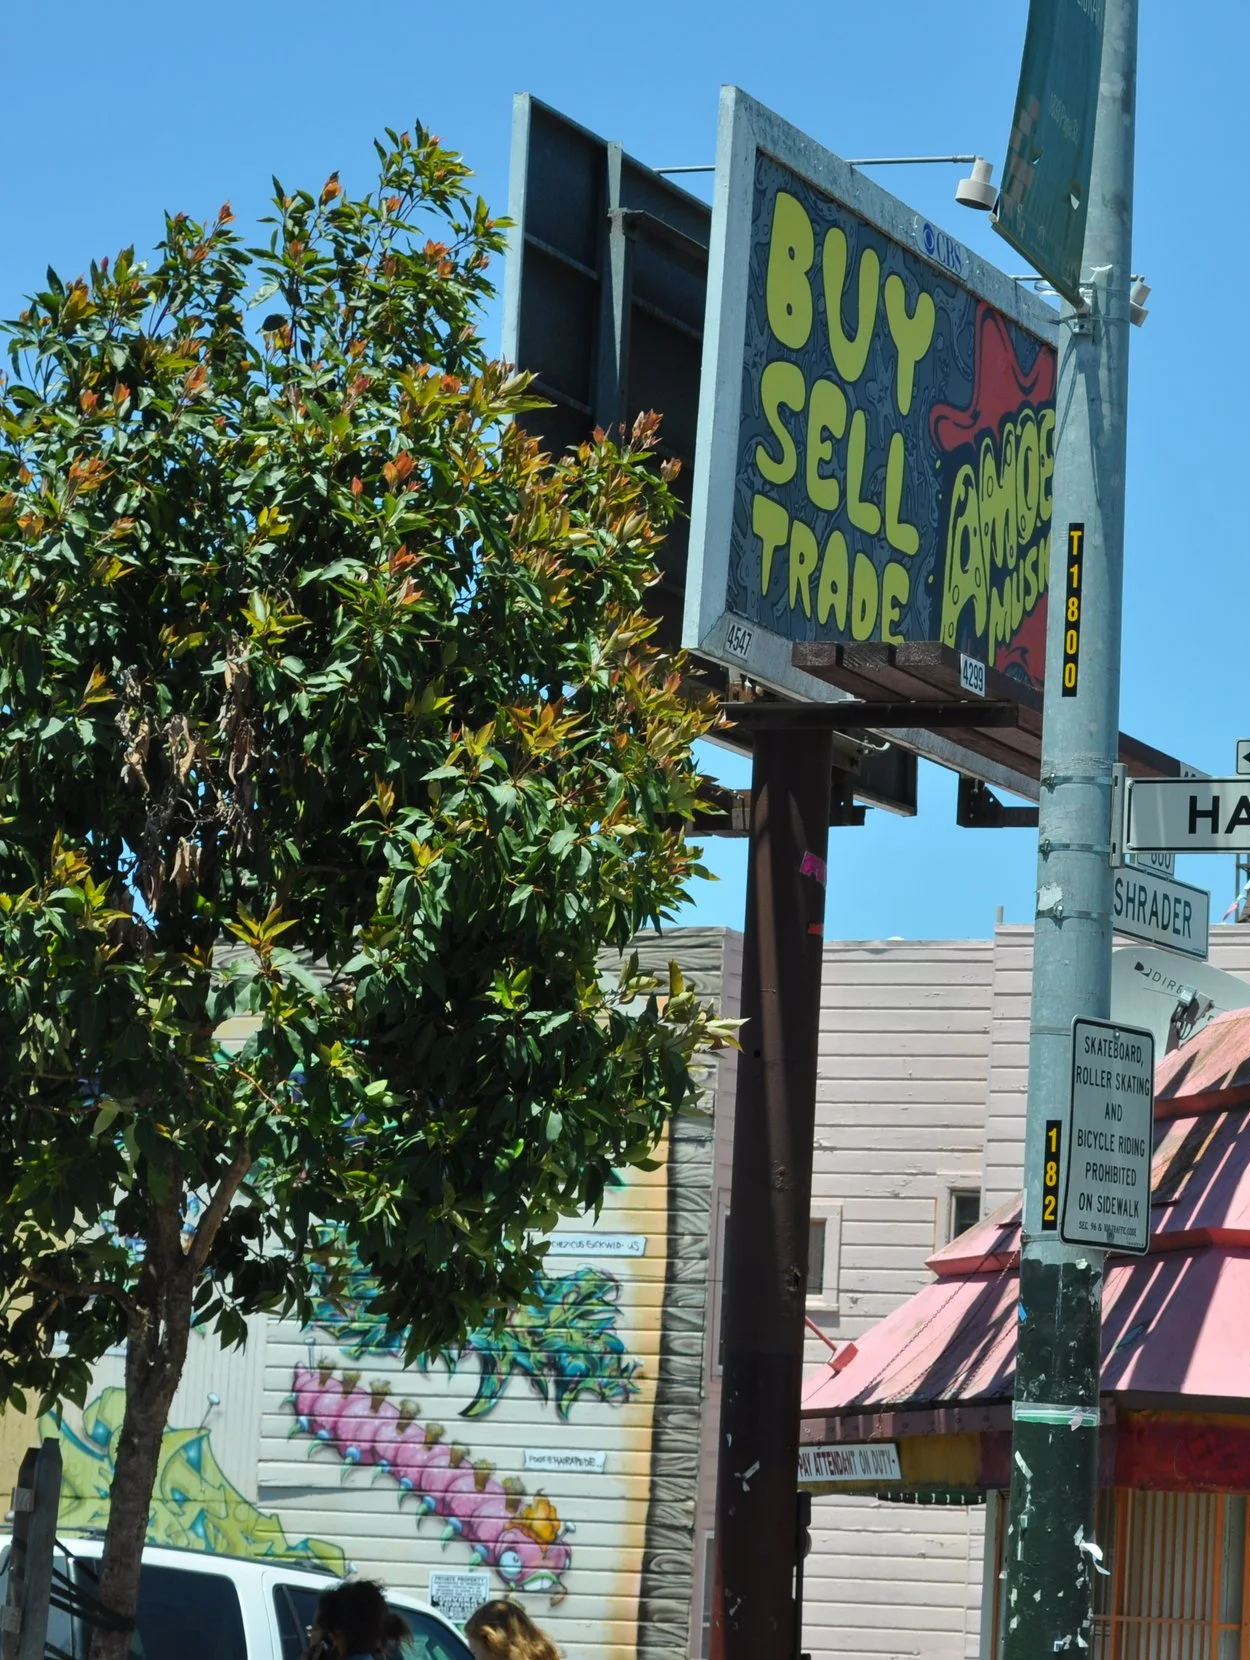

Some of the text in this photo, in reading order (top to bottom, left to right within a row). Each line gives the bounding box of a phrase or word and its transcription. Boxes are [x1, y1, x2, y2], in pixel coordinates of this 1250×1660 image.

[937, 232, 961, 274] CBS
[766, 191, 936, 416] BUY
[755, 361, 920, 555] SELL
[940, 408, 1055, 648] AMOE
[752, 494, 910, 645] TRADE
[1065, 531, 1082, 688] T1800
[728, 614, 752, 654] 4547
[962, 658, 984, 693] 4299
[1114, 877, 1192, 939] SHRADER
[1152, 971, 1184, 994] DIRE
[1084, 1036, 1144, 1066] SKATEBOARD,
[1076, 1066, 1150, 1096] ROLLER SKATING
[1104, 1102, 1123, 1122] AND
[1077, 1129, 1145, 1157] BICYCLE RIDING
[1044, 1127, 1058, 1221] 182
[1085, 1162, 1137, 1187] PROHIBITED
[1078, 1193, 1139, 1219] ON SIDEWALK
[813, 1451, 857, 1476] ATTENDANT
[859, 1450, 871, 1475] ON
[871, 1450, 893, 1475] DUTY
